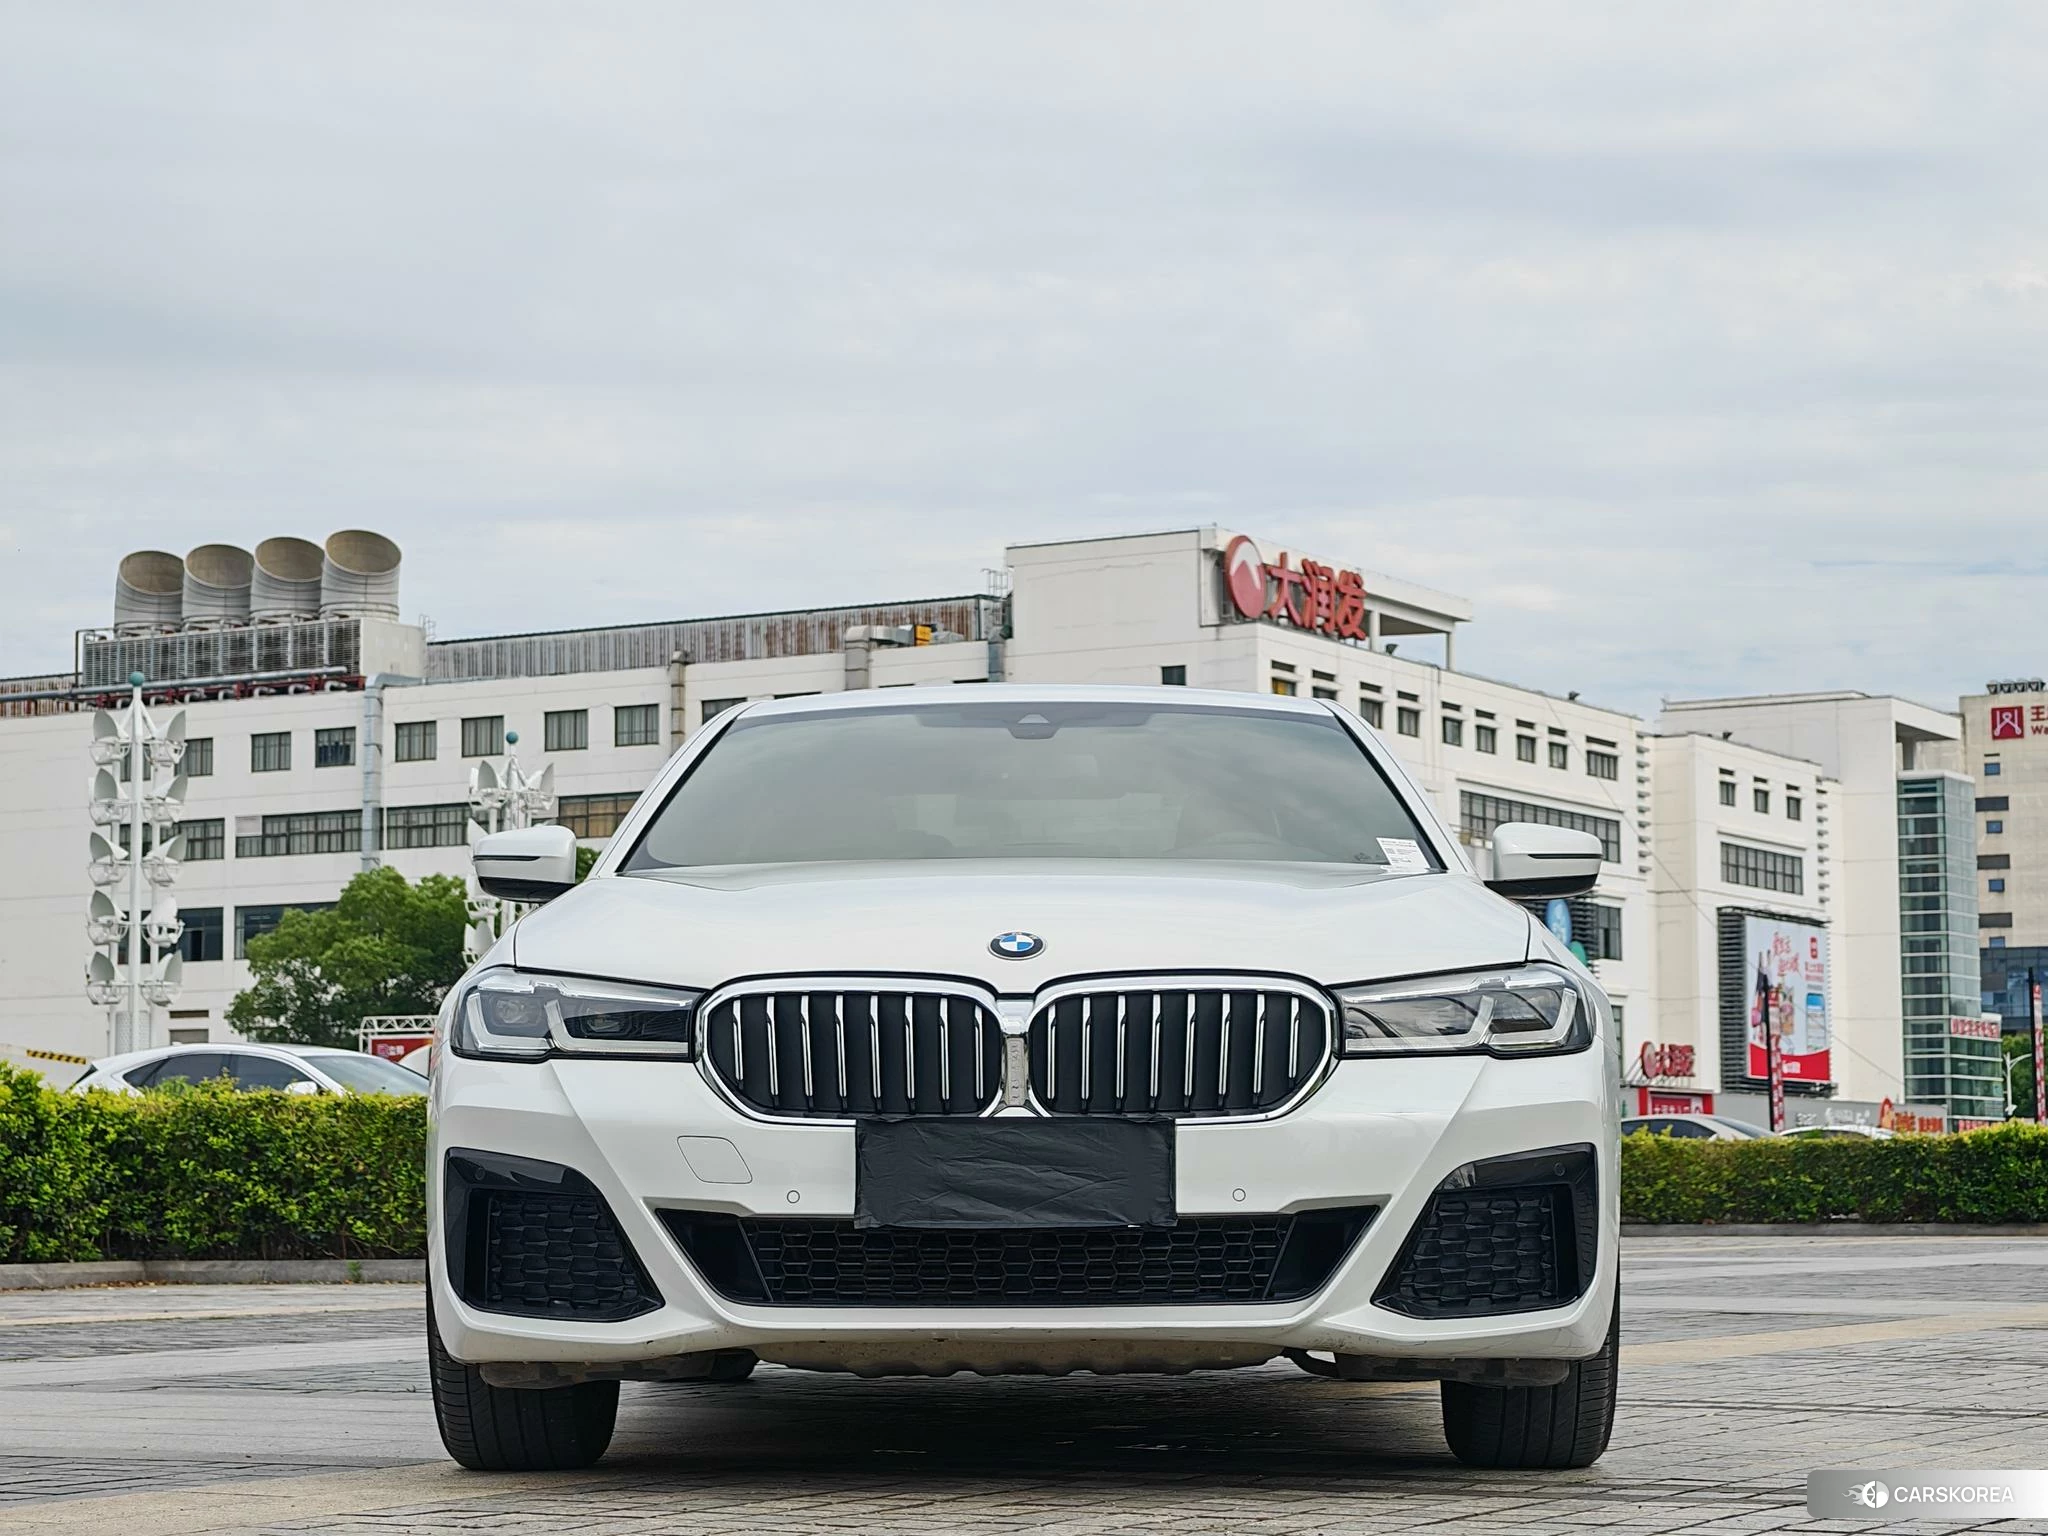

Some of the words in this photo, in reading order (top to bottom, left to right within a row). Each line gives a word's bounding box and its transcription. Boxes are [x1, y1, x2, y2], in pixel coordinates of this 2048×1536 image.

[1266, 552, 1367, 641] 大润发
[2030, 705, 2048, 722] 王
